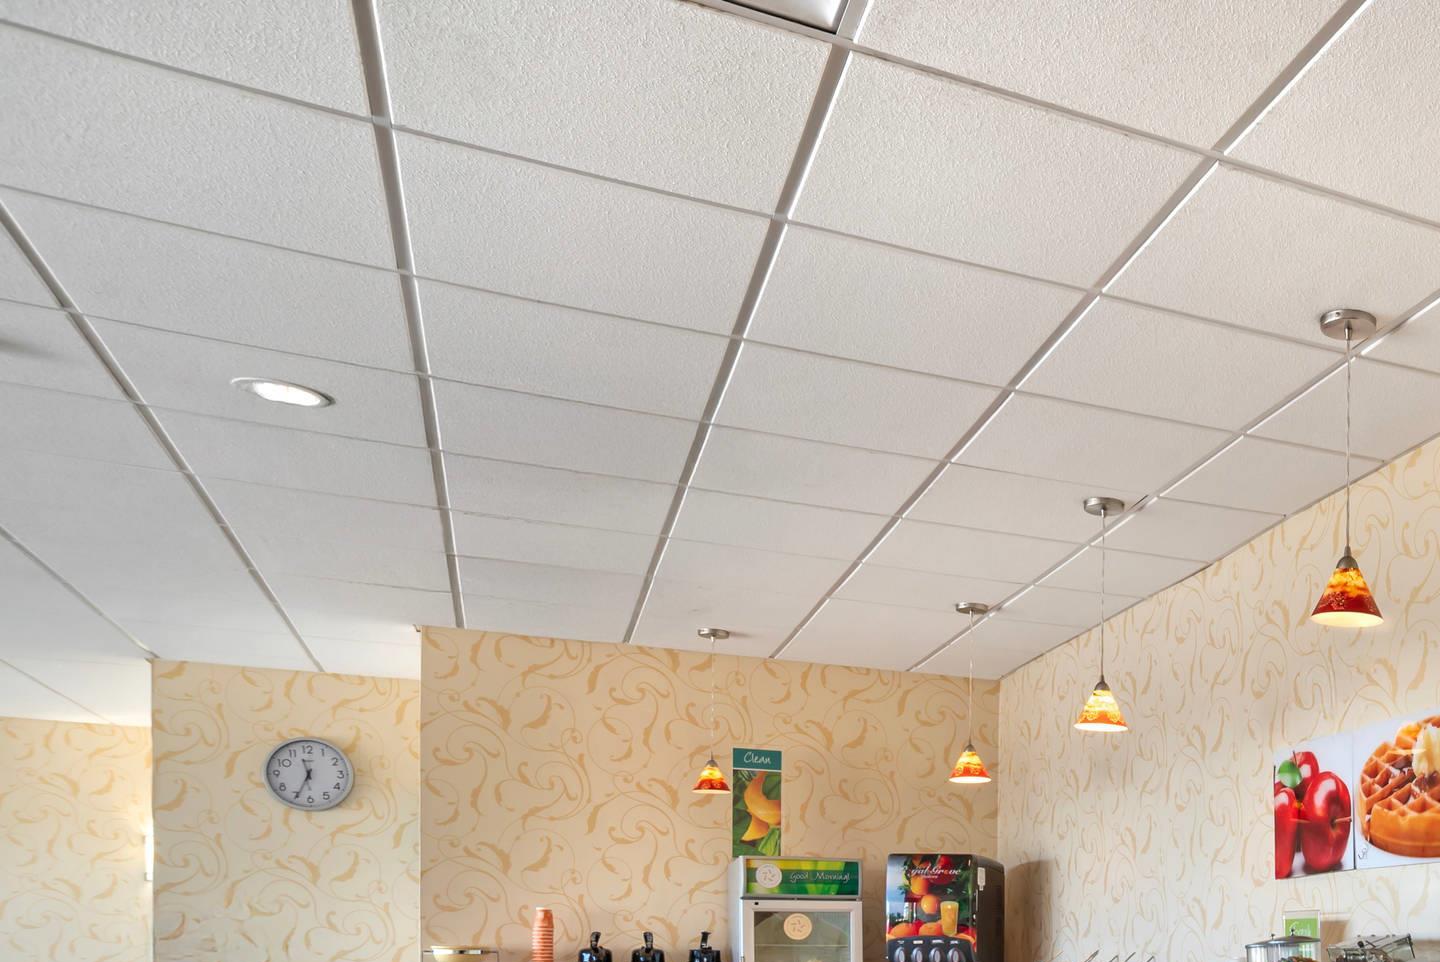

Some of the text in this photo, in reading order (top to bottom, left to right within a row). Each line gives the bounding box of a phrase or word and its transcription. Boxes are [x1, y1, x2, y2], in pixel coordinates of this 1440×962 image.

[289, 749, 297, 758] 11
[302, 745, 313, 755] 12
[321, 748, 325, 757] 1
[331, 757, 338, 766] 2
[743, 751, 771, 764] Clean
[278, 758, 292, 767] 10
[273, 769, 280, 778] 9
[337, 770, 345, 779] 3
[279, 782, 287, 791] 8
[333, 782, 341, 790] 4
[307, 795, 314, 804] 6
[323, 791, 330, 800] 5
[790, 872, 809, 883] Good
